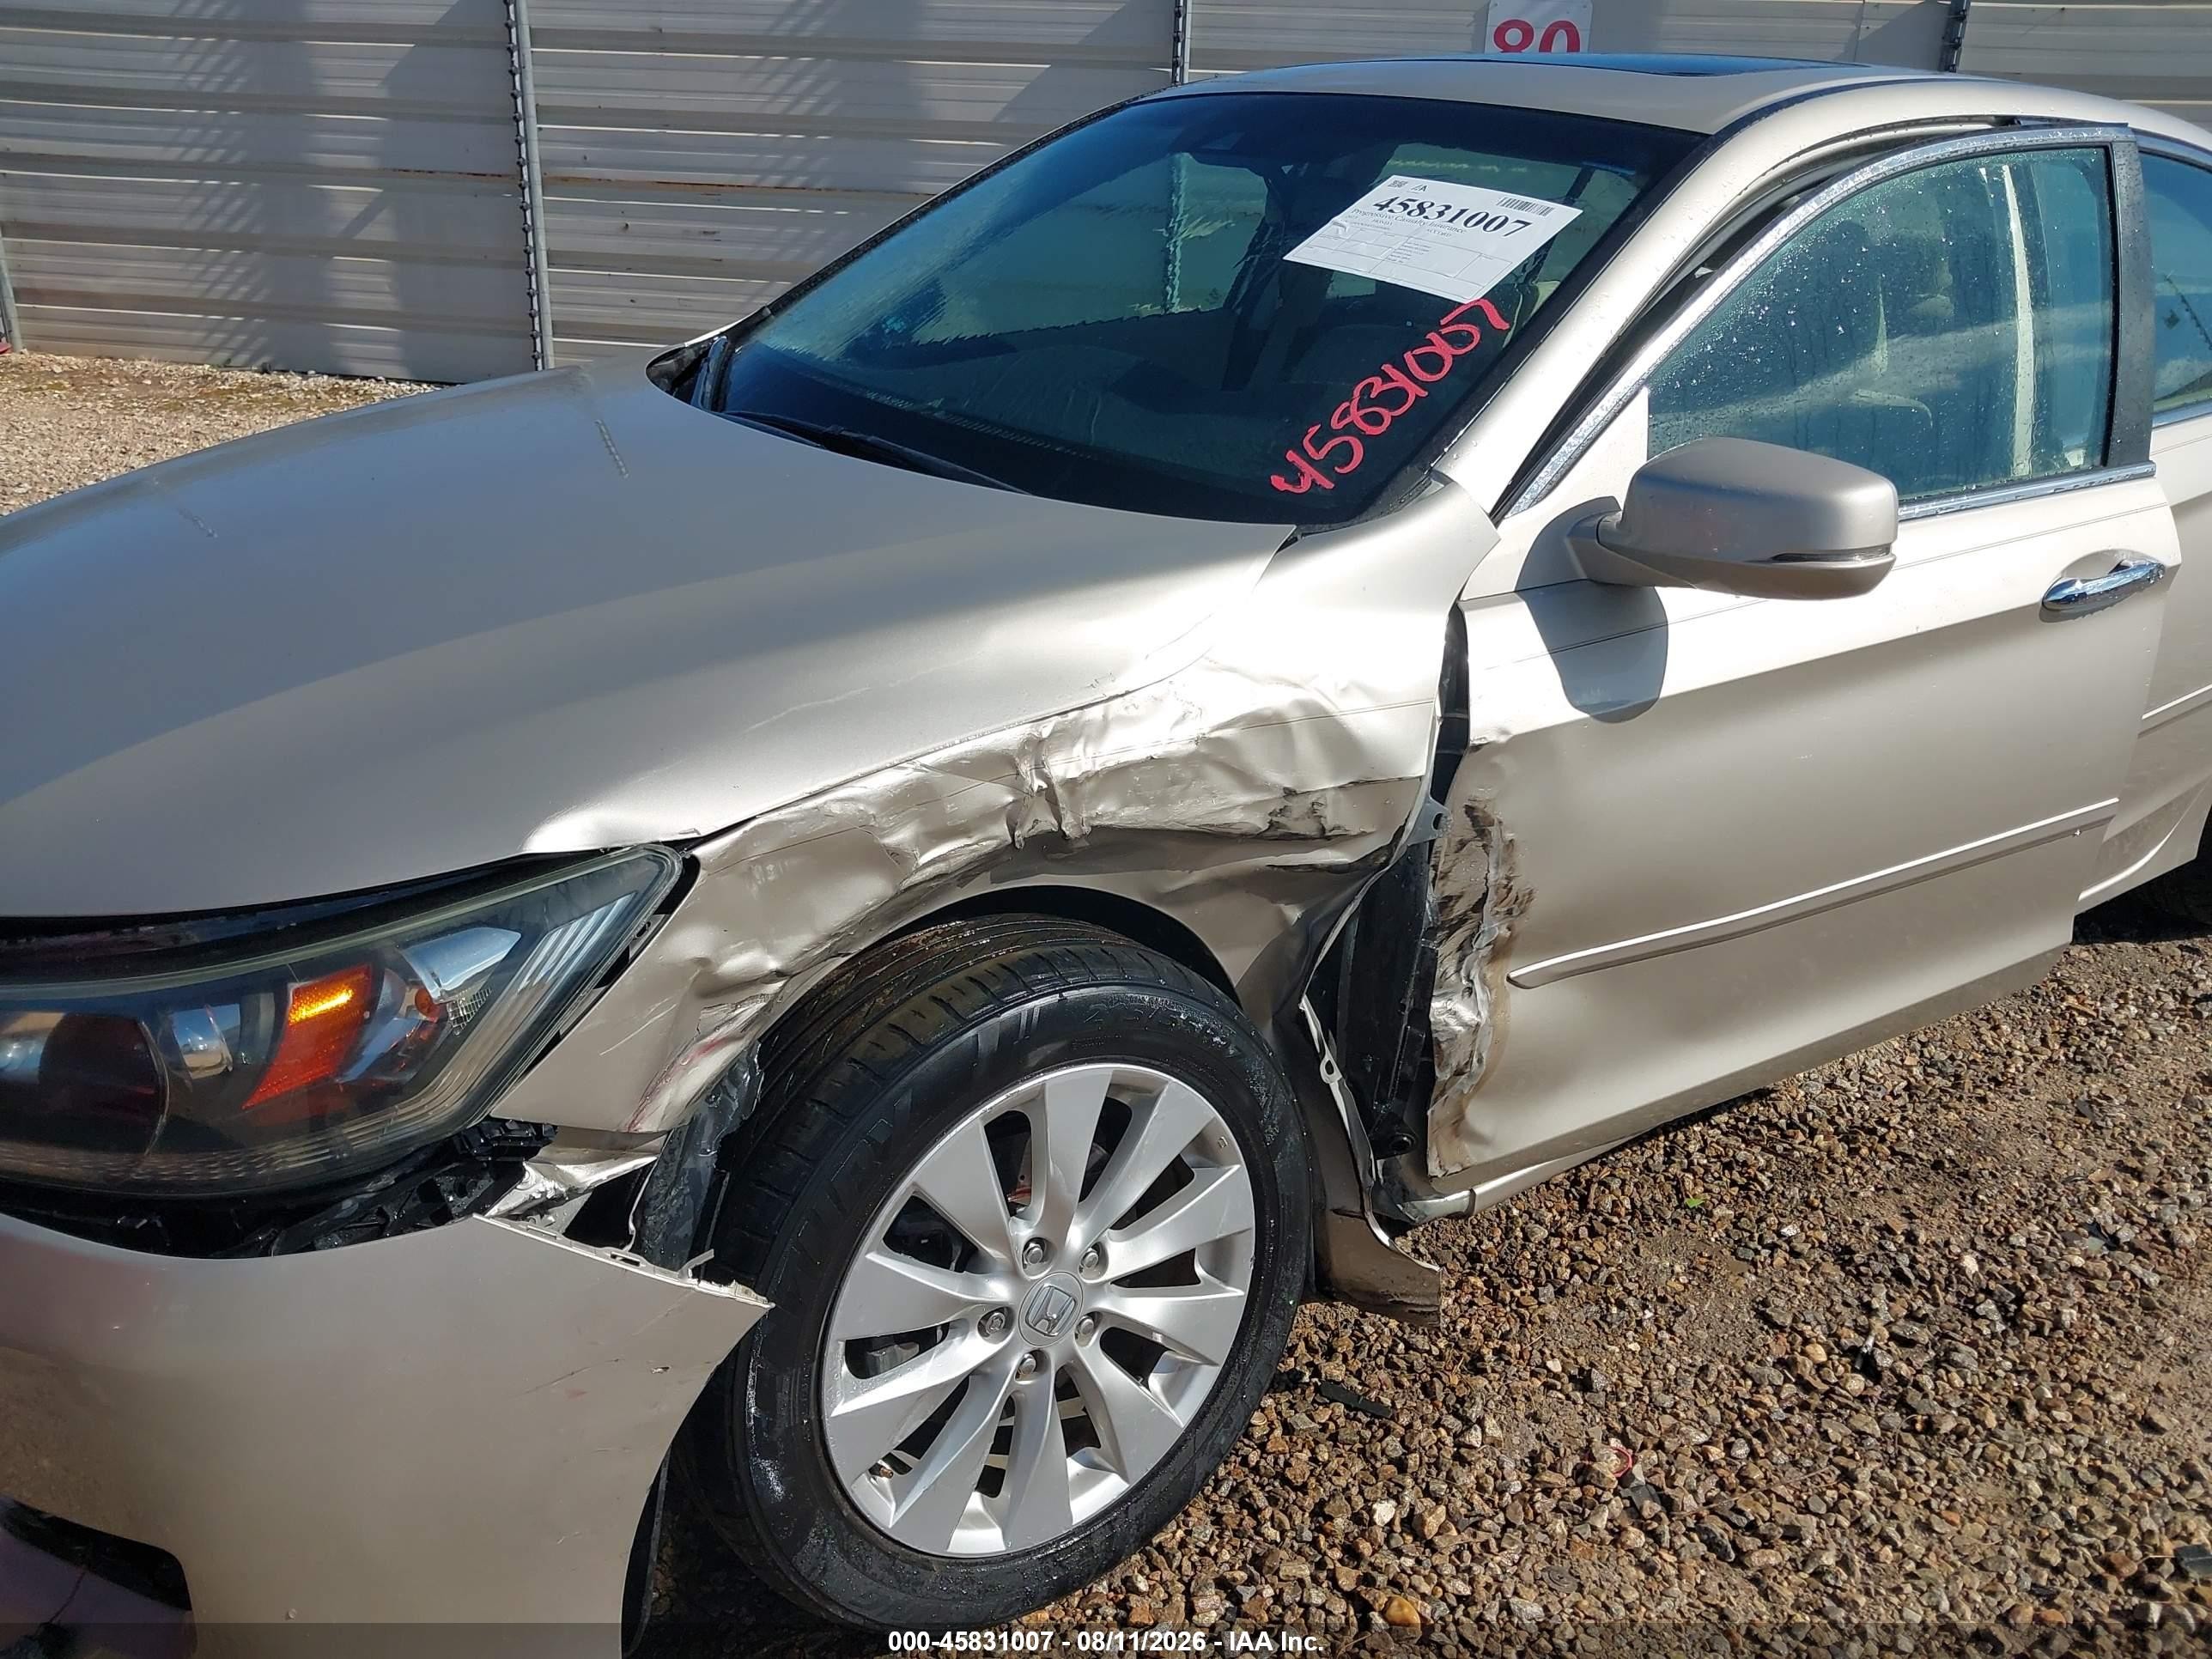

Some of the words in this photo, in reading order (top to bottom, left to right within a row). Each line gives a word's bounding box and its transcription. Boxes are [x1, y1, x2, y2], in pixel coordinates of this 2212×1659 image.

[1373, 196, 1532, 238] 45831007
[1395, 215, 1427, 227] Casualty
[1428, 221, 1467, 234] Insurance
[1270, 298, 1510, 495] 45831007
